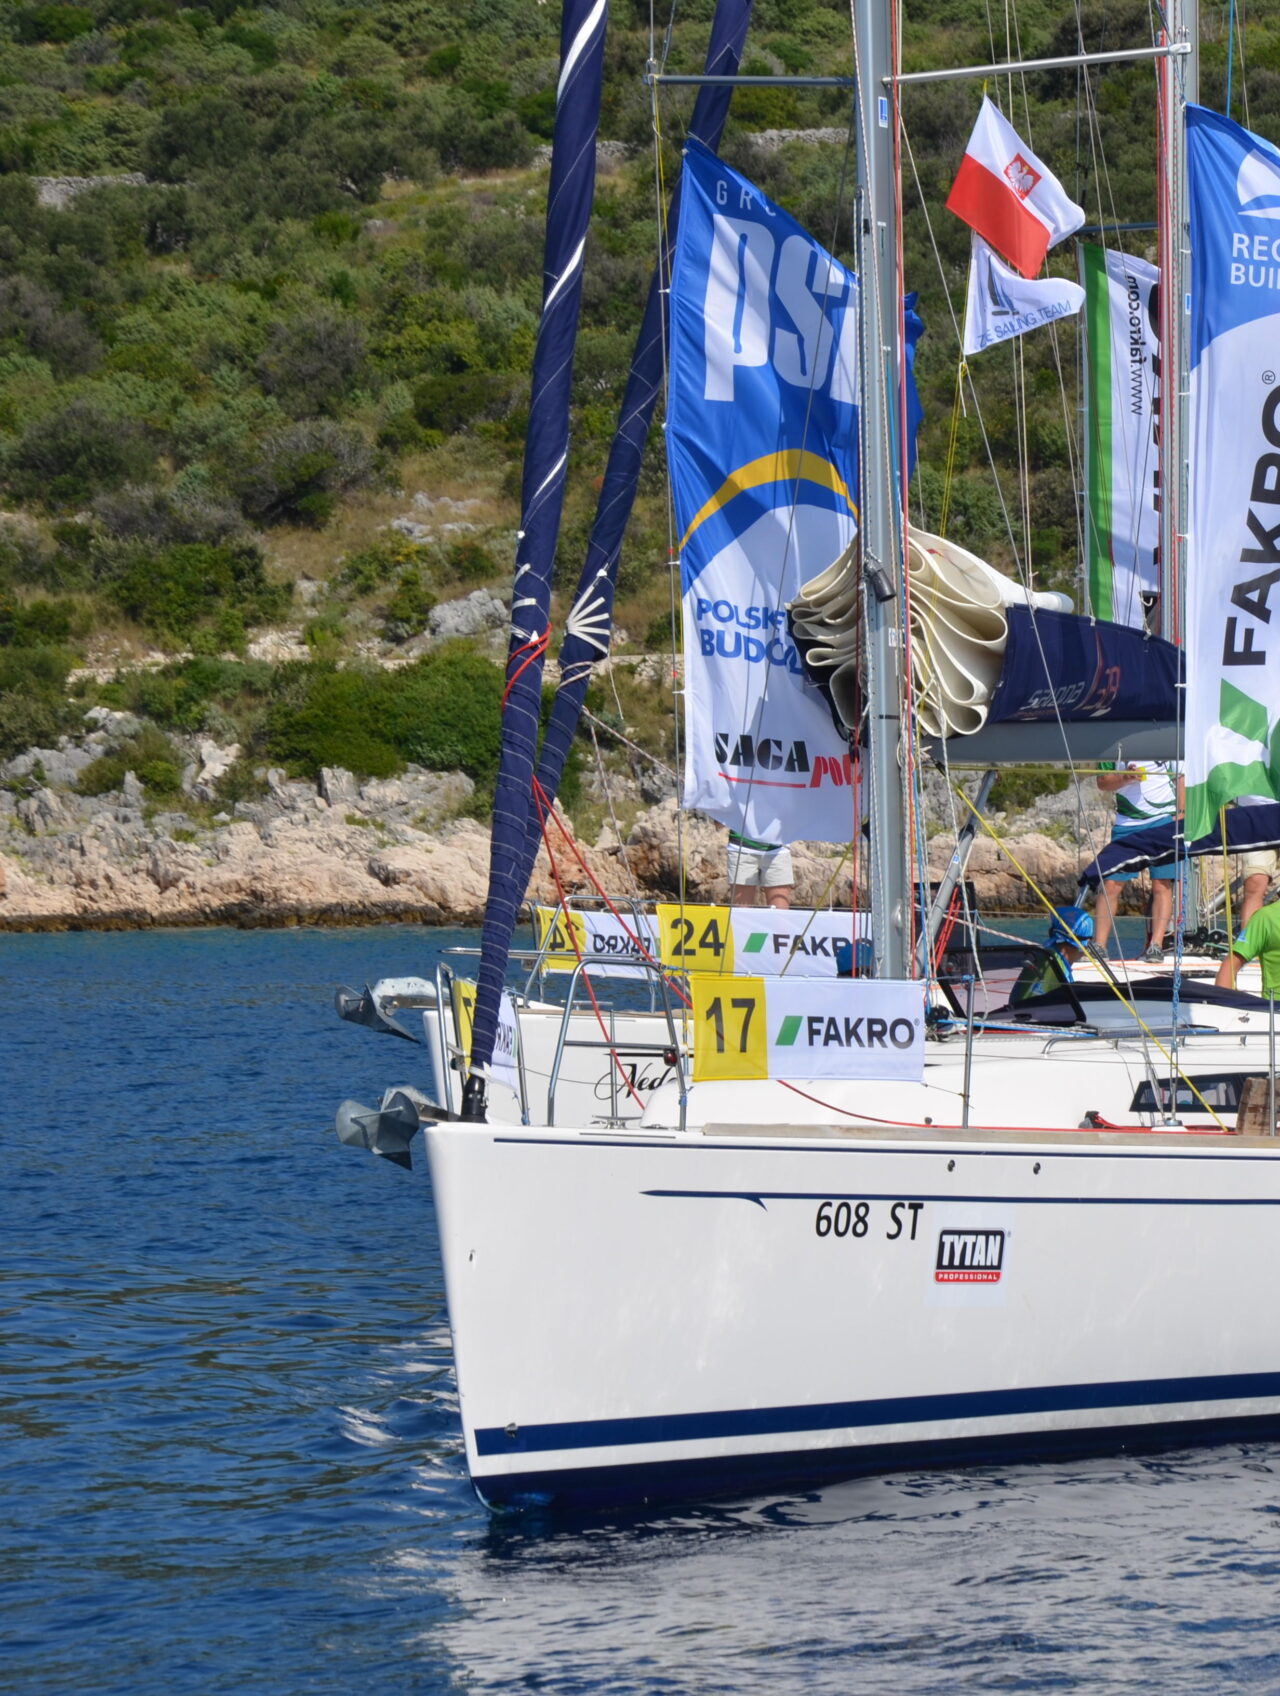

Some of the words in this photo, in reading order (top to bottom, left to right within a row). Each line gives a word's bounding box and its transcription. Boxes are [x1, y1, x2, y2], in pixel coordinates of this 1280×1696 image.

[1036, 300, 1072, 320] TEAM
[715, 733, 810, 772] SAGA
[671, 917, 724, 957] 24
[705, 996, 756, 1054] 17
[807, 1016, 915, 1050] FAKRO
[815, 1201, 870, 1238] 608
[886, 1202, 924, 1240] ST
[941, 1234, 1001, 1267] TYTAN
[938, 1273, 998, 1281] PROFESSIONAL
